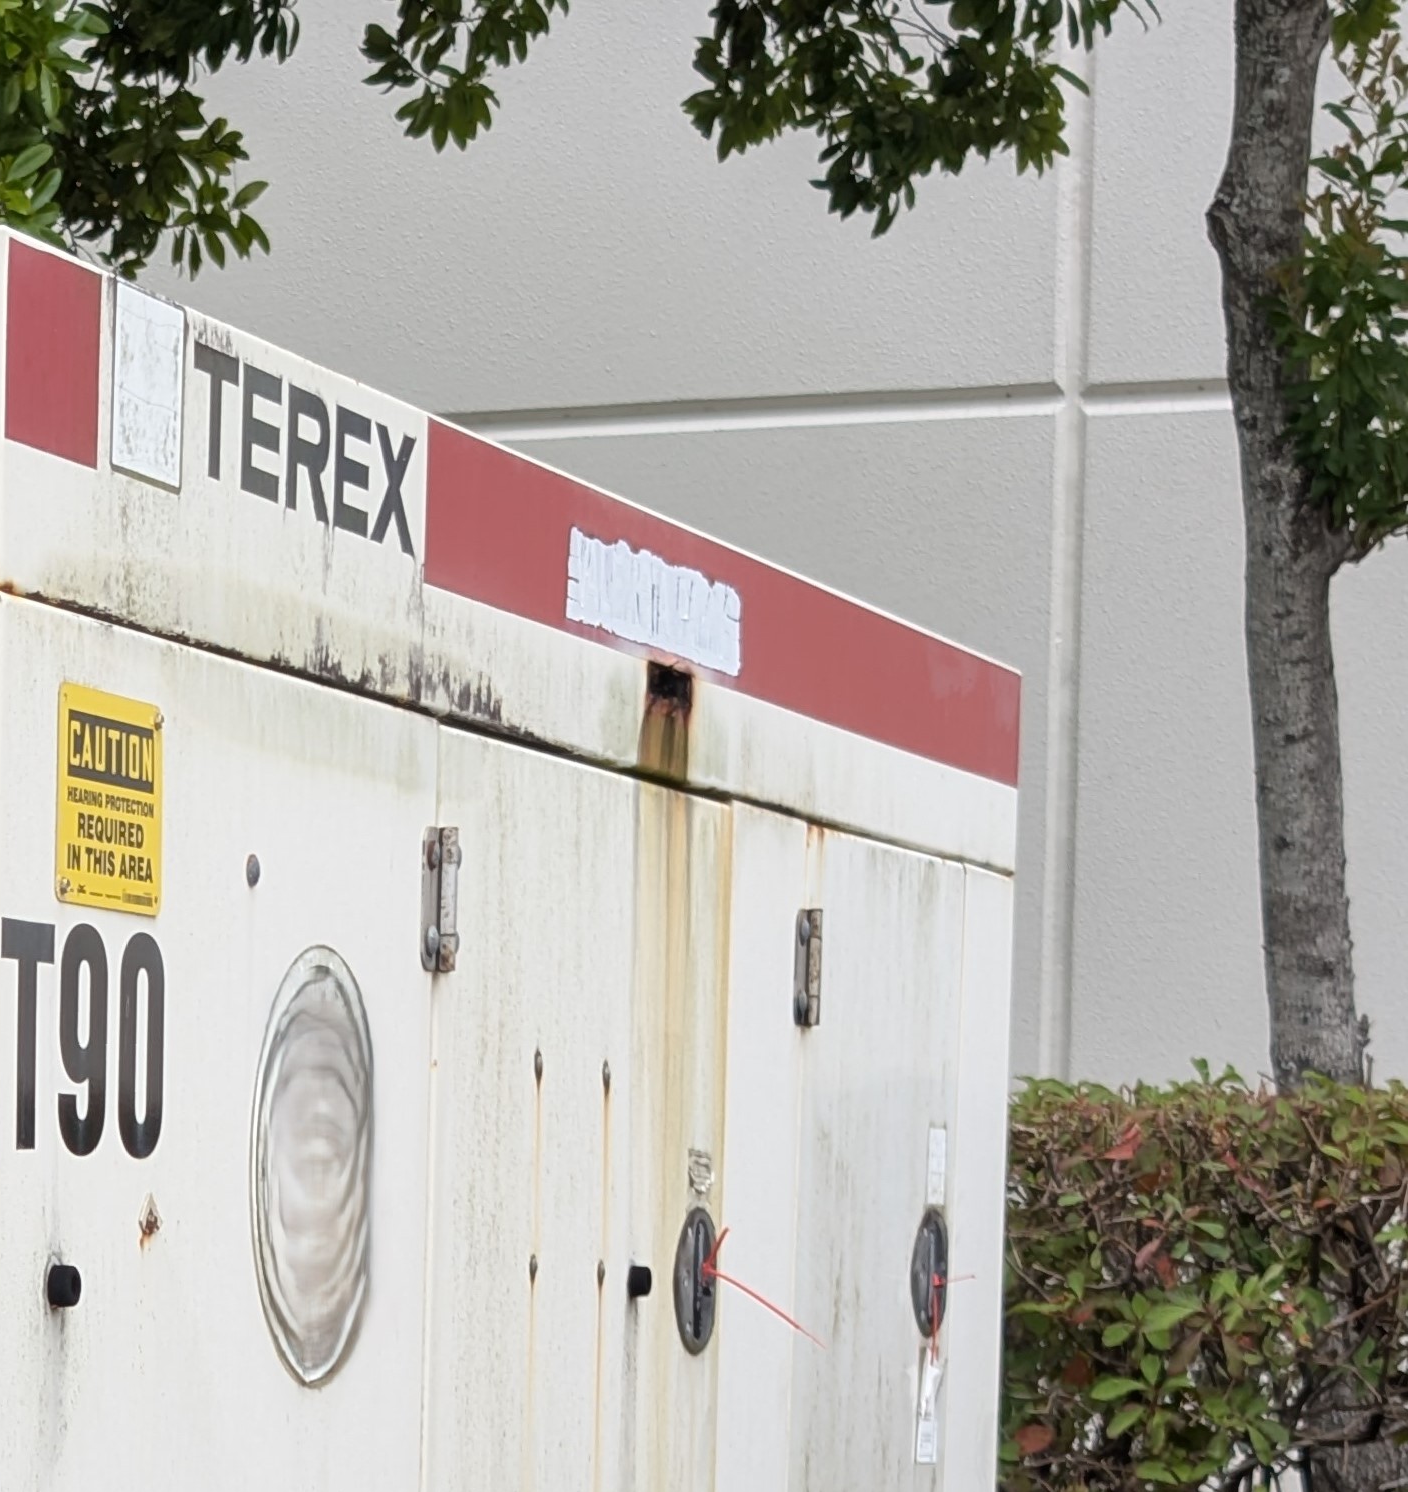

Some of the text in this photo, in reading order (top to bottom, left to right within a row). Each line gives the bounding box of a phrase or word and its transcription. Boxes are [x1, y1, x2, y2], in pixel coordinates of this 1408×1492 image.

[194, 341, 417, 558] TEREX
[69, 719, 153, 783] CAUTION
[67, 786, 155, 819] HEARING PROTECTION
[77, 812, 145, 850] REQUIRED
[67, 842, 153, 884] IN THIS AREA
[0, 916, 165, 1159] T90
